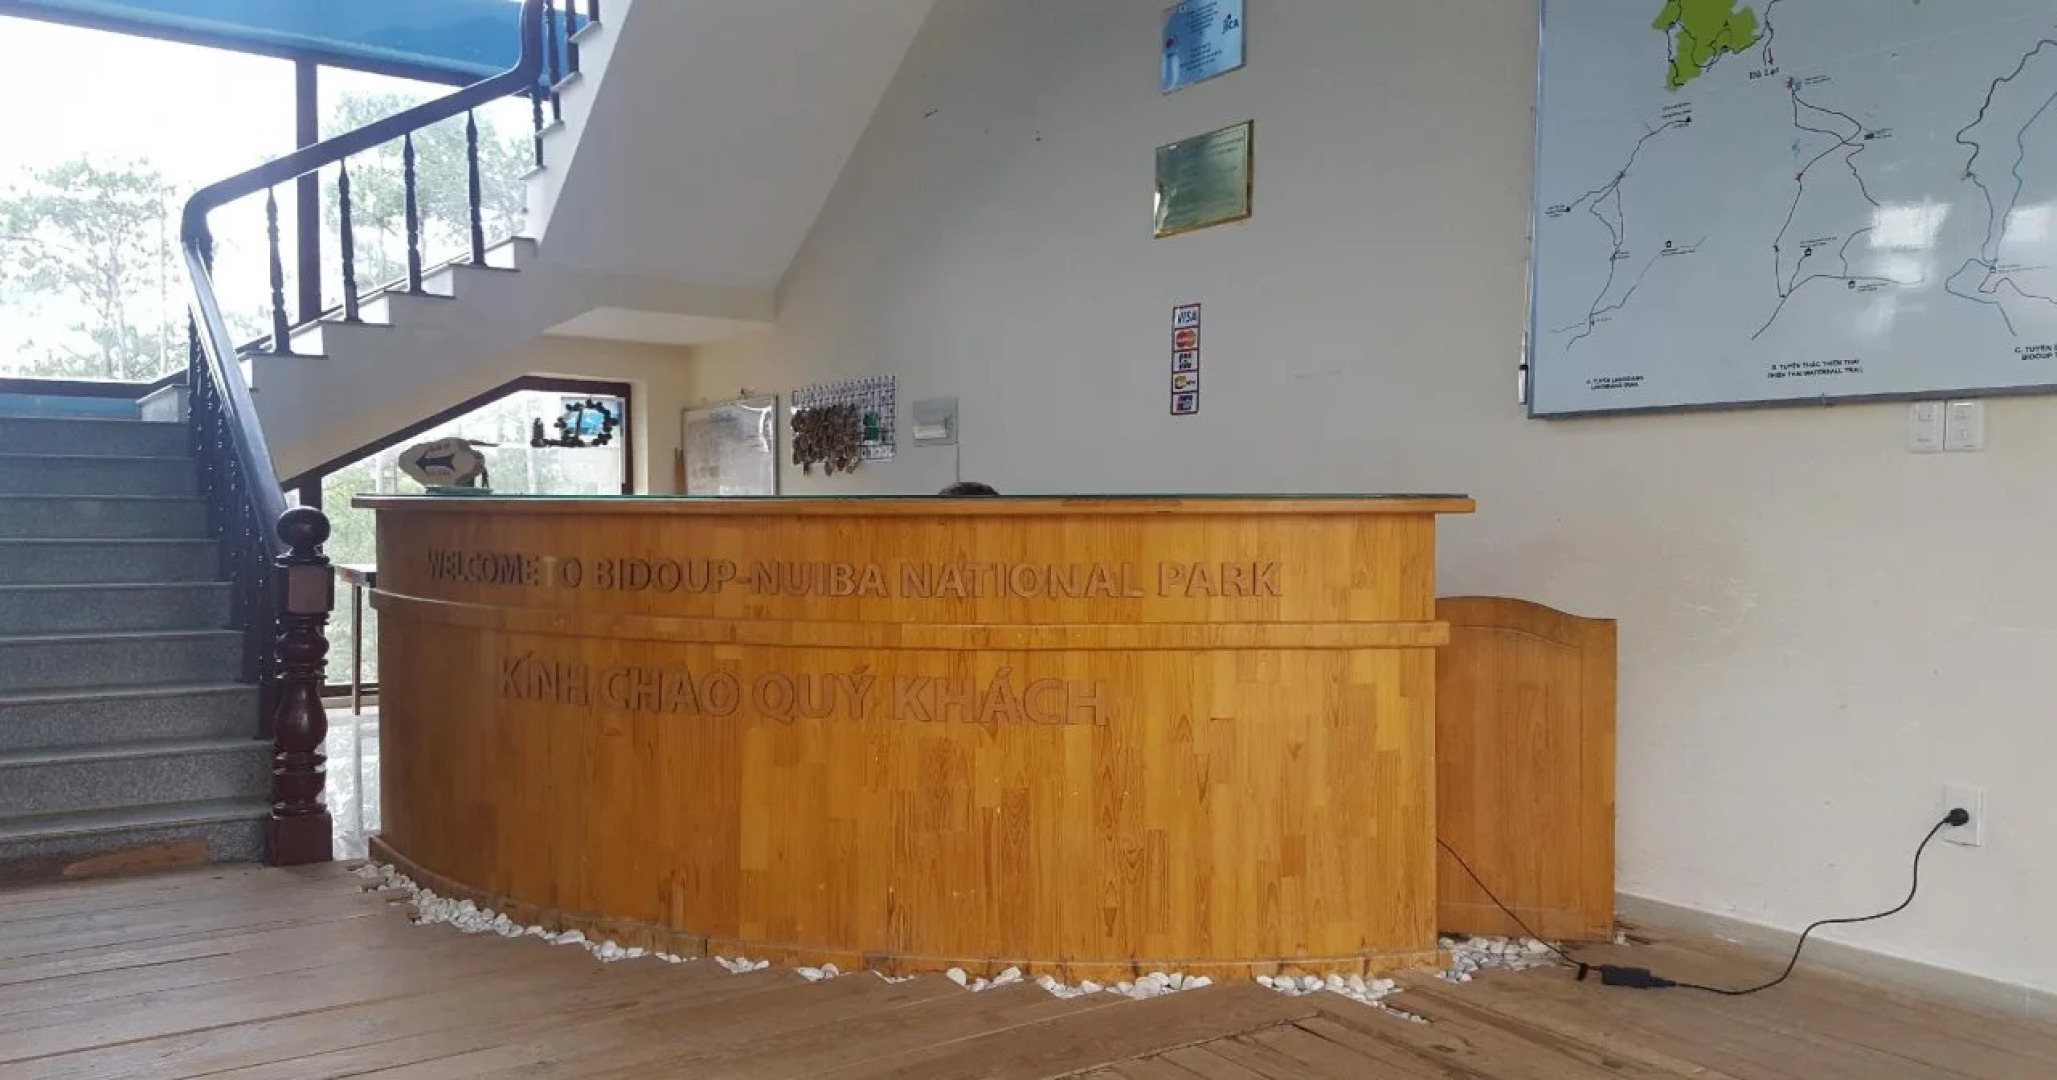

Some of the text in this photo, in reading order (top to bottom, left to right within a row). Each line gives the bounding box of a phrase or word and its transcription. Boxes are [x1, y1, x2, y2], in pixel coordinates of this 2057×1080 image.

[1177, 308, 1197, 324] VISA
[427, 550, 1284, 599] WELCOME TO BIDOUP-NUIBA NATIONAL PARK
[502, 650, 592, 706] KÍNH
[751, 664, 877, 726] QUÝ
[893, 666, 1109, 727] KHÁCH
